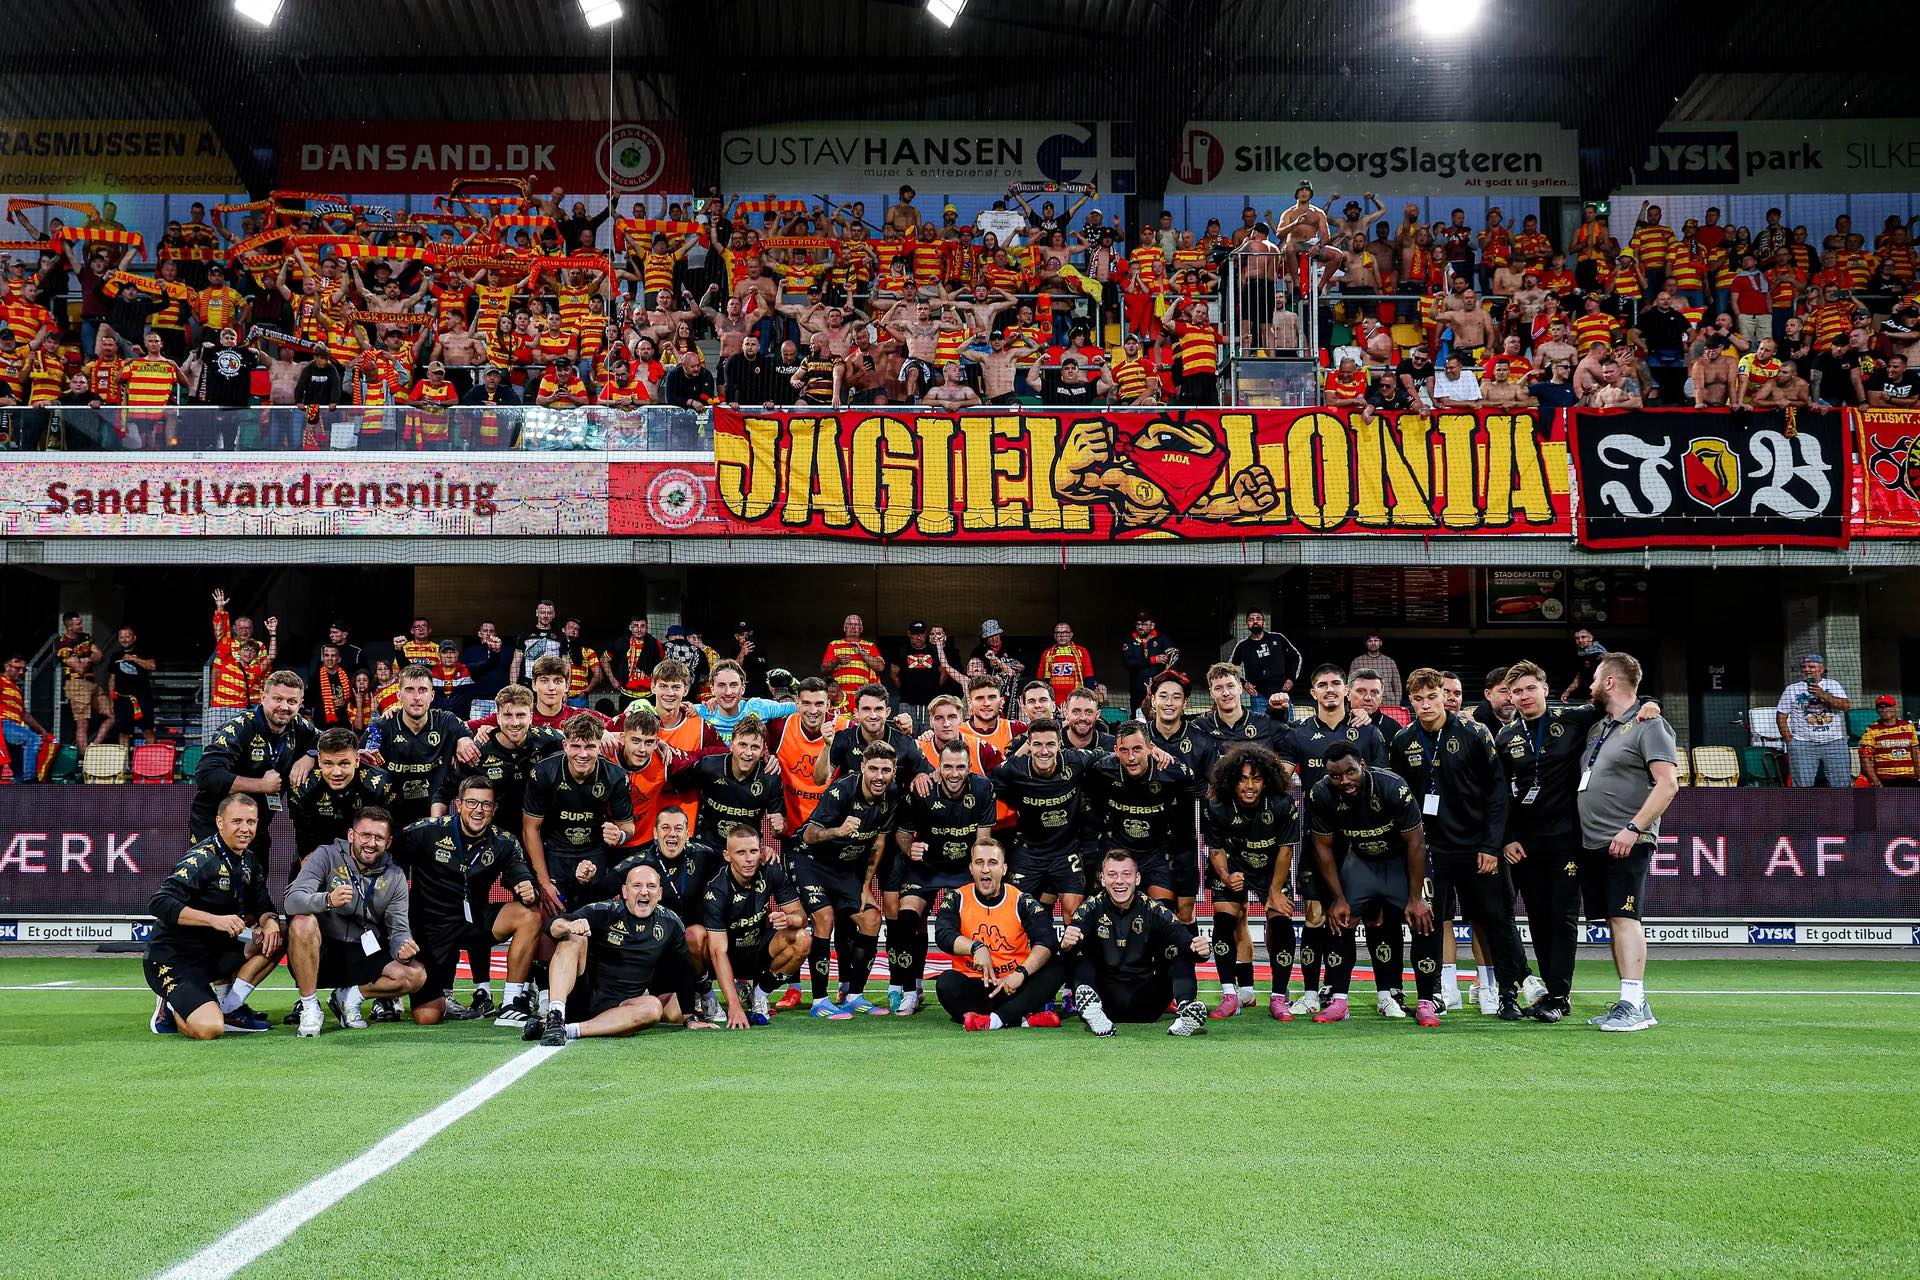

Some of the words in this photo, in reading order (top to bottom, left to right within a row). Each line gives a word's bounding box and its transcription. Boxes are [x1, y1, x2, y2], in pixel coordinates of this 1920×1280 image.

[301, 143, 556, 171] DANSAND.DK
[1234, 144, 1542, 178] SilkeborgSlagteren
[1643, 144, 1733, 171] JYSK
[1746, 142, 1823, 176] park
[1846, 142, 1920, 168] SILKE
[864, 168, 900, 176] murer
[906, 168, 913, 176] &
[1486, 178, 1512, 188] godt
[1516, 178, 1528, 186] til
[792, 239, 830, 247] TRAVEL
[1162, 453, 1190, 465] JAGA
[47, 480, 148, 515] Sand
[161, 479, 203, 515] til
[210, 472, 498, 516] vandrensning
[1712, 674, 1723, 690] E
[1023, 788, 1077, 806] SUPERBET
[1108, 799, 1166, 814] SUPERBET
[0, 832, 142, 873] ÆRK
[1764, 836, 1848, 877] AF
[1067, 853, 1083, 873] 2
[0, 925, 17, 938] SK
[28, 924, 42, 937] Et
[44, 924, 69, 941] godt
[72, 923, 113, 938] tilbud
[1644, 928, 1658, 939] Et
[1660, 927, 1690, 941] godt
[1692, 927, 1729, 939] tilbud
[1756, 928, 1795, 941] JYSK
[1806, 929, 1819, 939] Et
[1821, 928, 1852, 943] godt
[1854, 928, 1892, 941] tilbud
